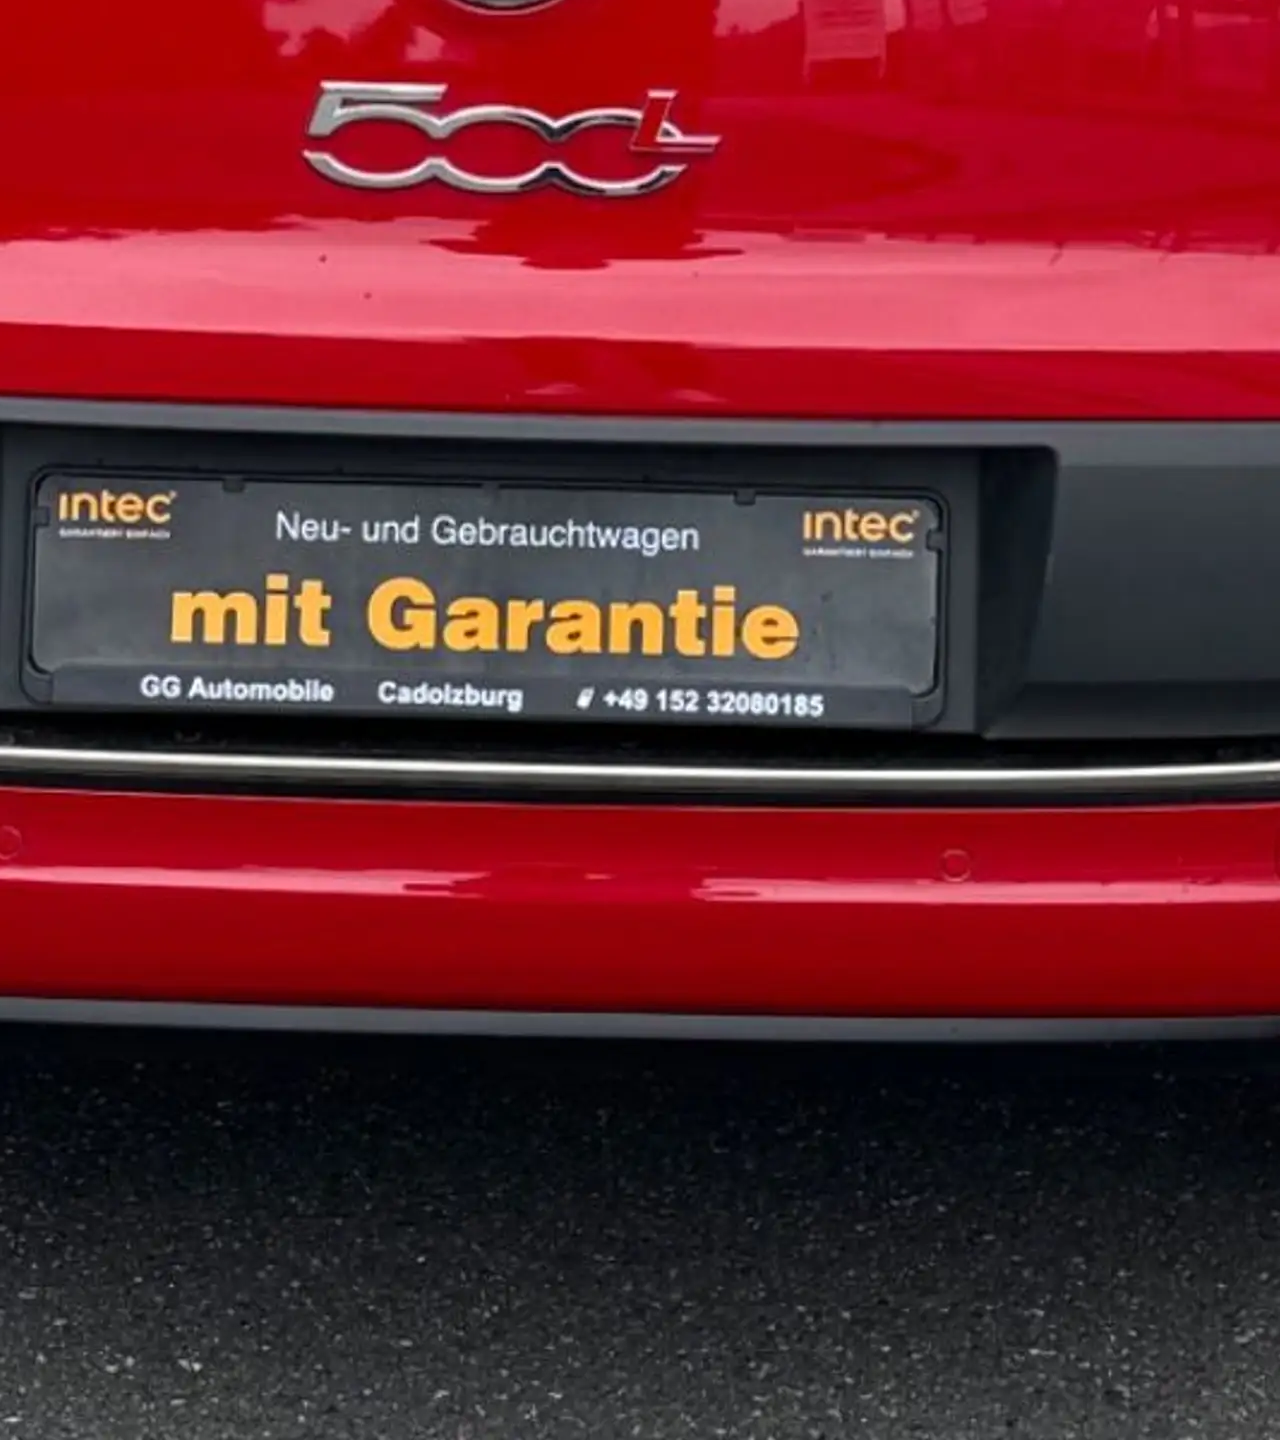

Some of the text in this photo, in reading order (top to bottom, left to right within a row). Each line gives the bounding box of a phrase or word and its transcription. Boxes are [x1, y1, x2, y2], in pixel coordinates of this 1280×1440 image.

[58, 489, 173, 525] intec
[275, 511, 701, 558] Neu- und Gebrauchtwagen
[802, 507, 916, 544] intec
[170, 573, 799, 660] mit Garantie
[140, 674, 335, 702] GG Automobile
[377, 681, 523, 713] Cadolzburg
[603, 688, 648, 711] +49
[655, 689, 699, 712] 152
